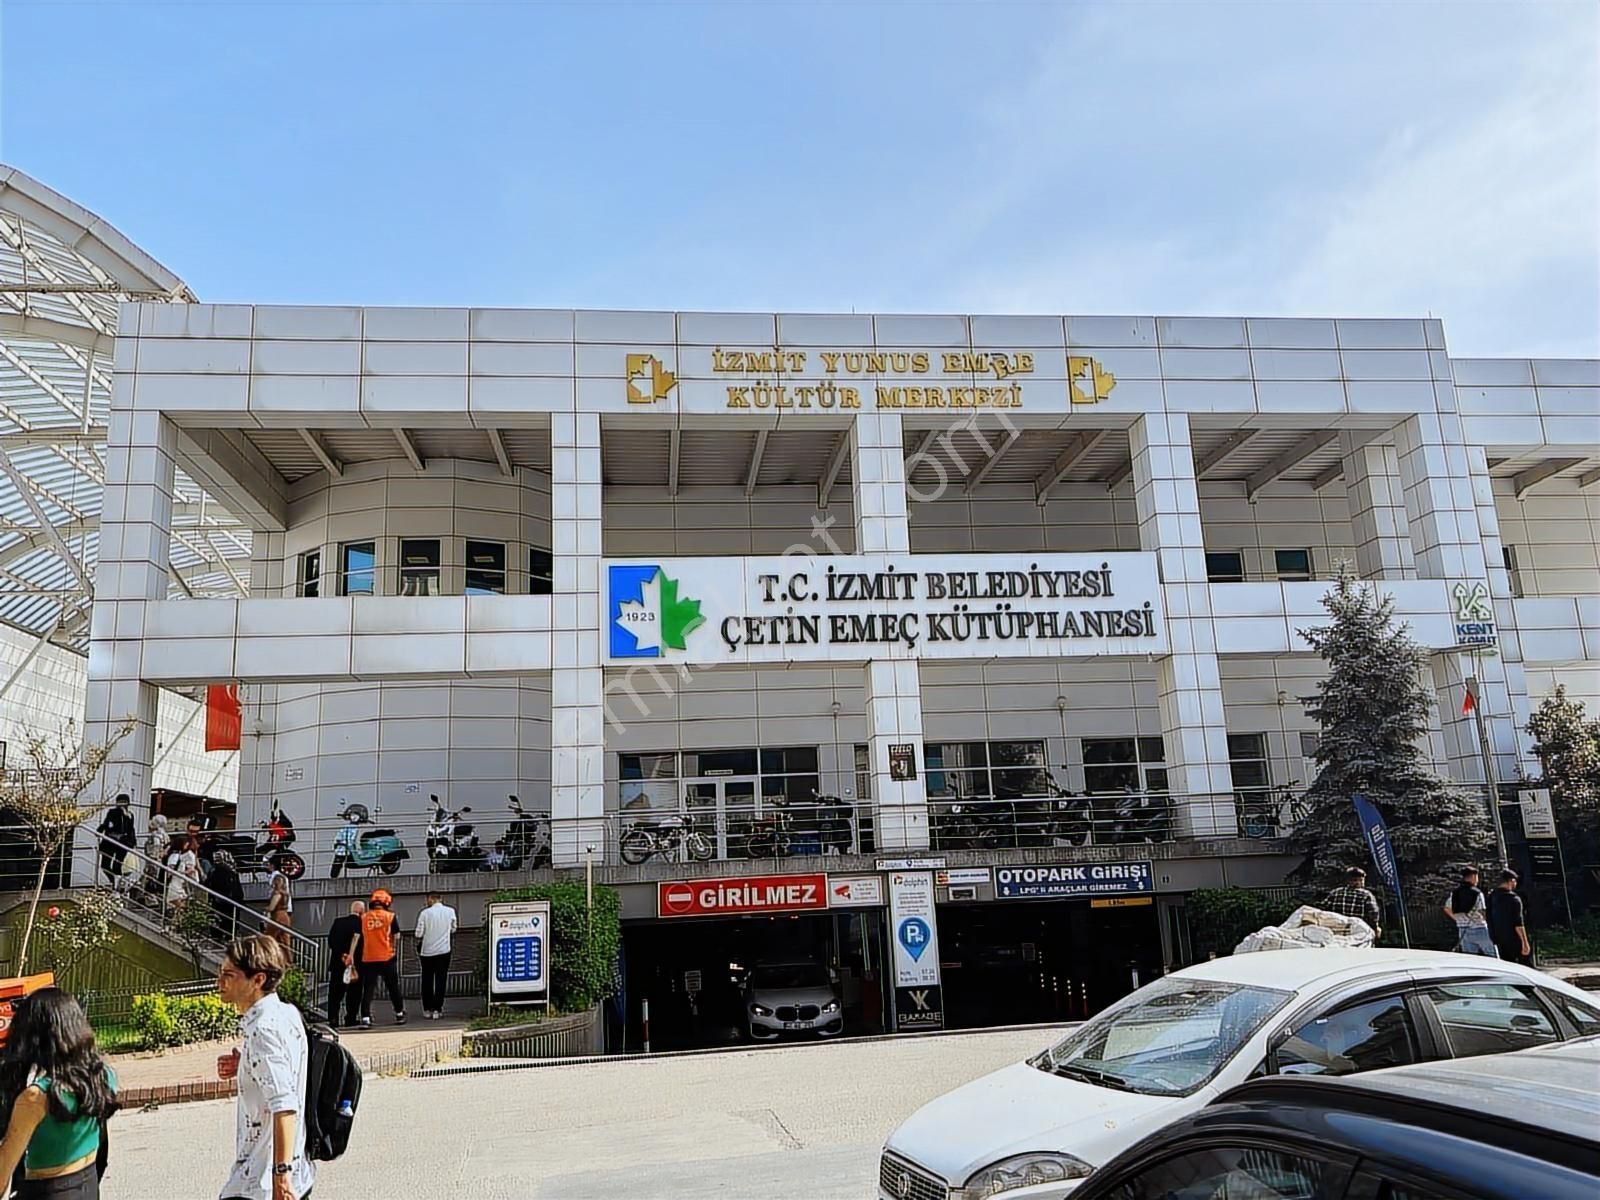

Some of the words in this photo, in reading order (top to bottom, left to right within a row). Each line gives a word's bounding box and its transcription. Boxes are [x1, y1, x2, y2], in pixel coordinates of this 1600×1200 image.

[712, 345, 806, 372] İZMİT
[820, 352, 929, 373] YUNUS
[942, 352, 1034, 380] EMRE
[726, 381, 860, 408] KÜLTÜR
[876, 382, 1022, 408] MERKEZİ
[825, 565, 917, 601] İZMİT
[925, 562, 1114, 600] BELEDİYESİ
[626, 612, 656, 622] 1923
[720, 606, 820, 652] ÇETİN
[828, 613, 920, 649] EMEÇ
[926, 601, 1157, 641] KÜTÜPHANESİ
[1456, 623, 1495, 635] KENT
[998, 867, 1087, 884] OTOPARK
[699, 883, 817, 908] GİRİLMEZ
